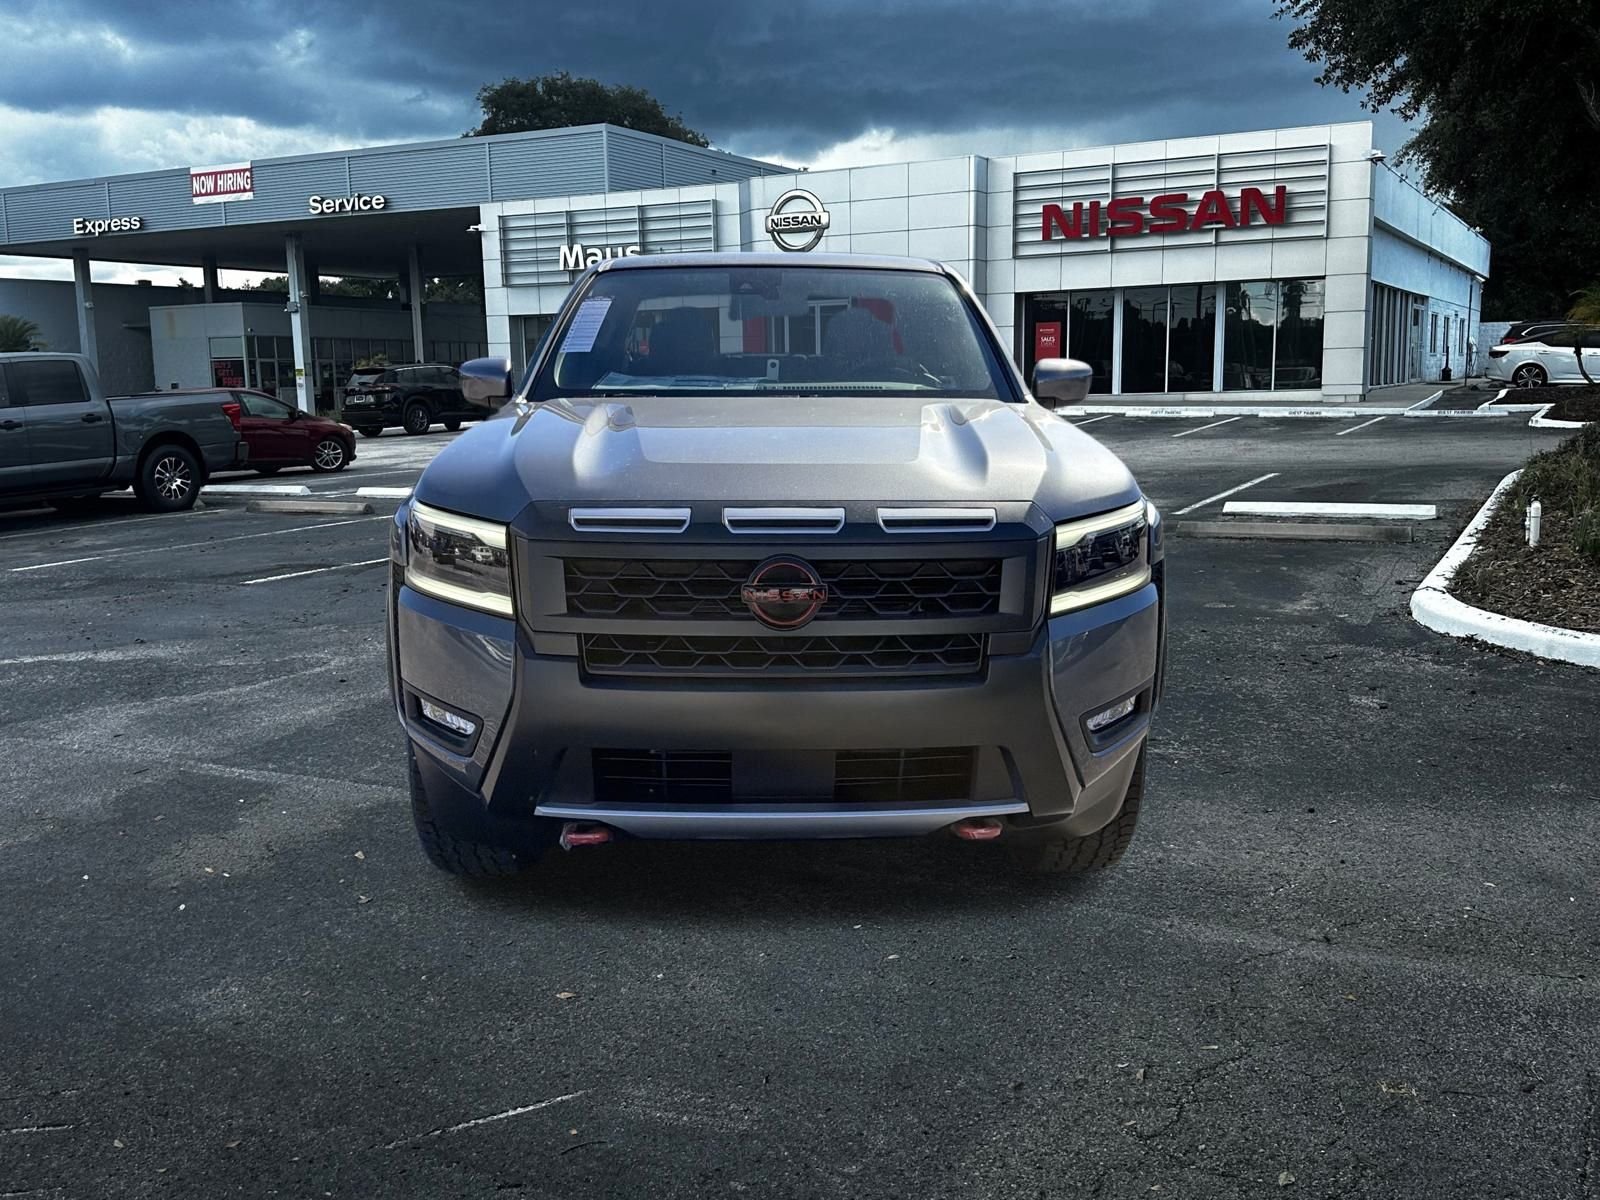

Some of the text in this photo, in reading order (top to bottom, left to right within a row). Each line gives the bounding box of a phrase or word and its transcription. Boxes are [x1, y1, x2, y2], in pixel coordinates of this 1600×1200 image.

[192, 171, 251, 195] NOW HIRING
[308, 193, 385, 214] Service
[1042, 185, 1287, 241] NISSAN
[73, 216, 141, 236] Express
[770, 214, 822, 228] NISSAN
[560, 243, 641, 270] Maus
[742, 588, 825, 601] NISSAN
